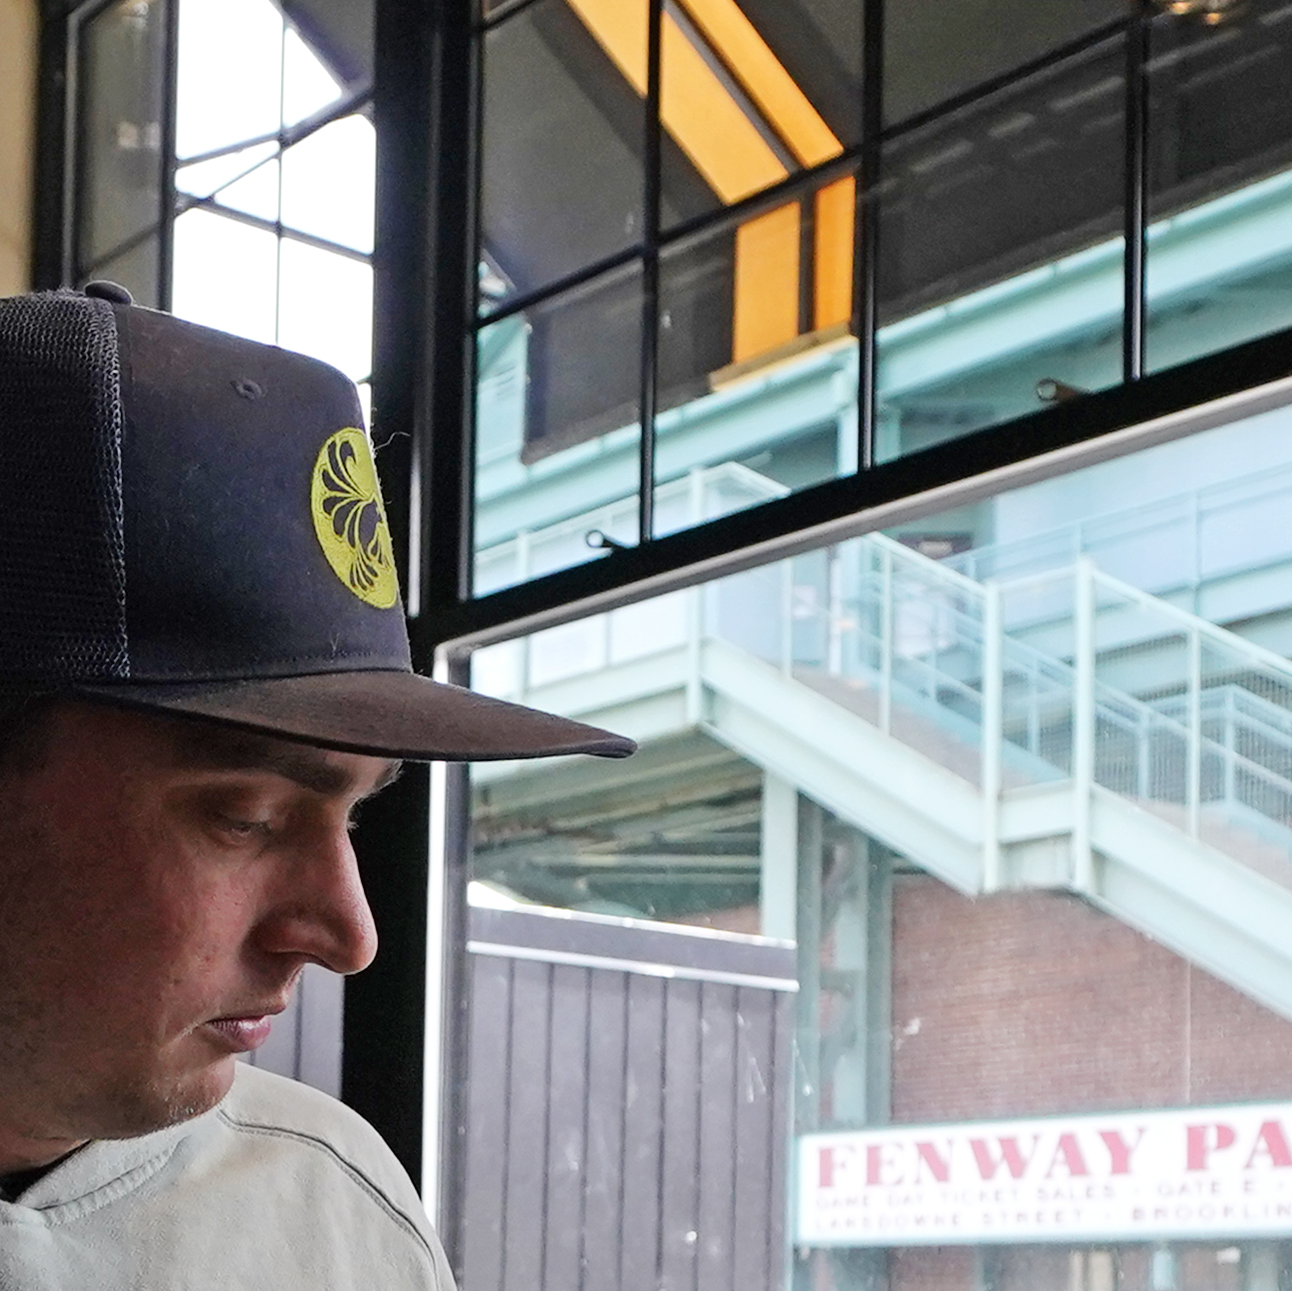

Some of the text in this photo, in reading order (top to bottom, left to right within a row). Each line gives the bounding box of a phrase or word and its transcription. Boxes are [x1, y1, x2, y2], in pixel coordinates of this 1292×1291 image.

[819, 1127, 1146, 1188] FENWAY
[943, 1188, 1018, 1205] TICKET
[1037, 1184, 1117, 1202] SALES
[1158, 1180, 1221, 1196] GATE
[983, 1208, 1082, 1226] STREET
